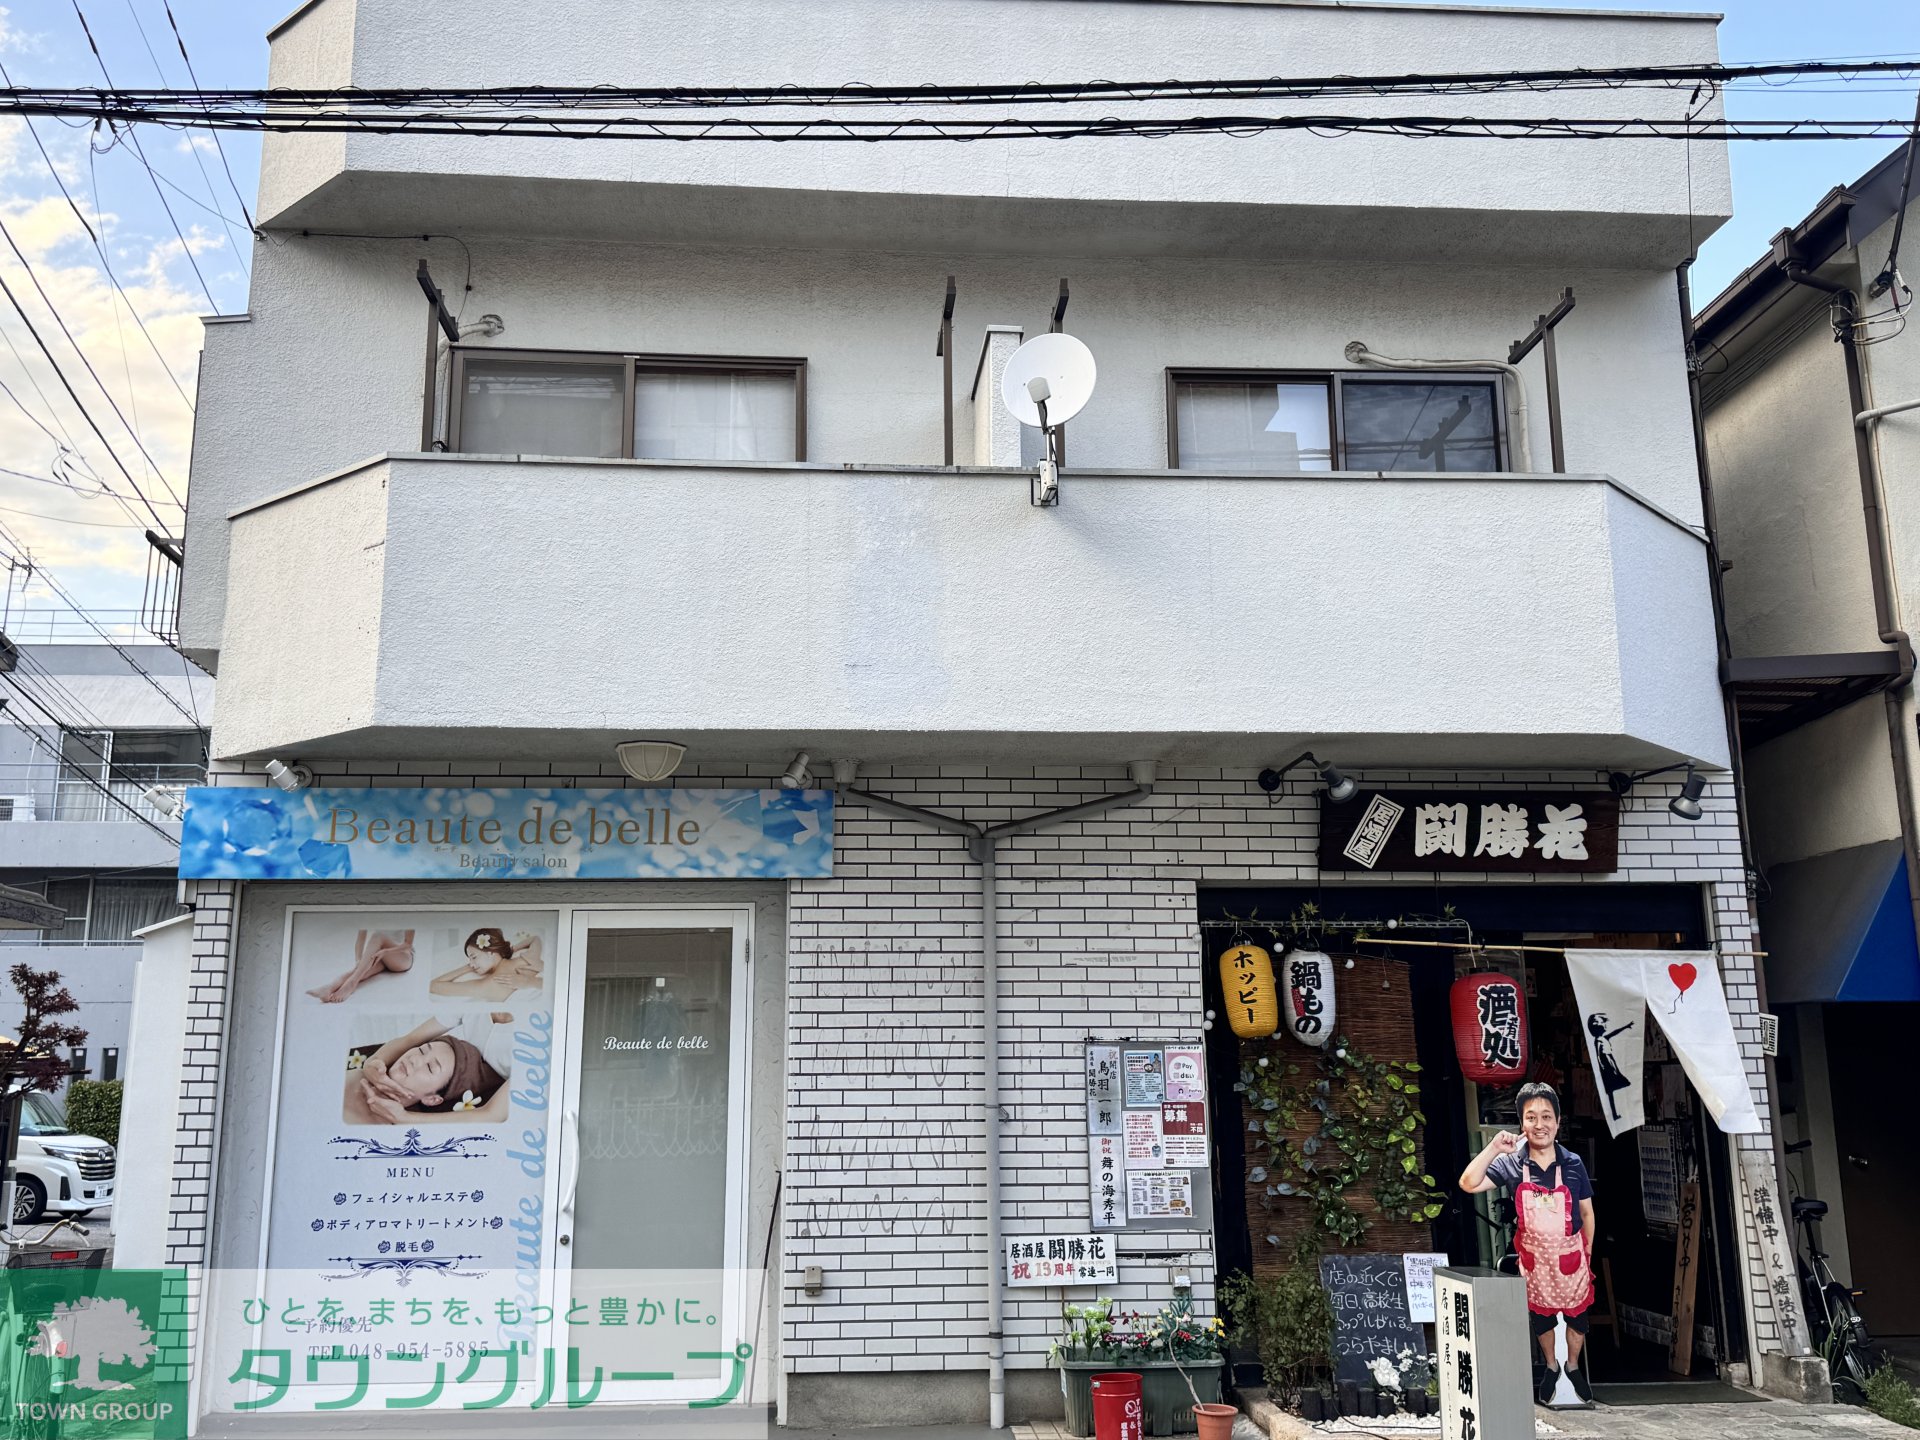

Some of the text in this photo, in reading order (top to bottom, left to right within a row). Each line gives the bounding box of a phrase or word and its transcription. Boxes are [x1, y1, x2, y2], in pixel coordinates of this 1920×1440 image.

[328, 806, 701, 845] Beaute de belle
[1352, 804, 1394, 858] 居酒屋
[1414, 803, 1589, 860] 闘勝花
[459, 853, 568, 869] Beauty salon
[1233, 951, 1258, 1024] ホッピー
[1290, 961, 1323, 1034] 鍋もの
[603, 1036, 709, 1050] Beaute de belle
[510, 1010, 553, 1112] belle
[1098, 1060, 1112, 1126] 鳥羽一郎
[506, 1127, 546, 1179] de
[386, 1167, 435, 1178] MENU
[352, 1192, 468, 1204] フェイシャルエステ
[1101, 1156, 1116, 1225] 舞の海秀平
[326, 1217, 489, 1231] ボディアロマトリートメント
[395, 1241, 419, 1253] 脱毛
[1011, 1260, 1075, 1280] 祝 13周年
[285, 1317, 372, 1334] ご予約優先
[309, 1341, 489, 1360] TEL 048-954-5885
[1336, 1335, 1418, 1355] うらやましい
[1454, 1292, 1476, 1440] 闘勝花
